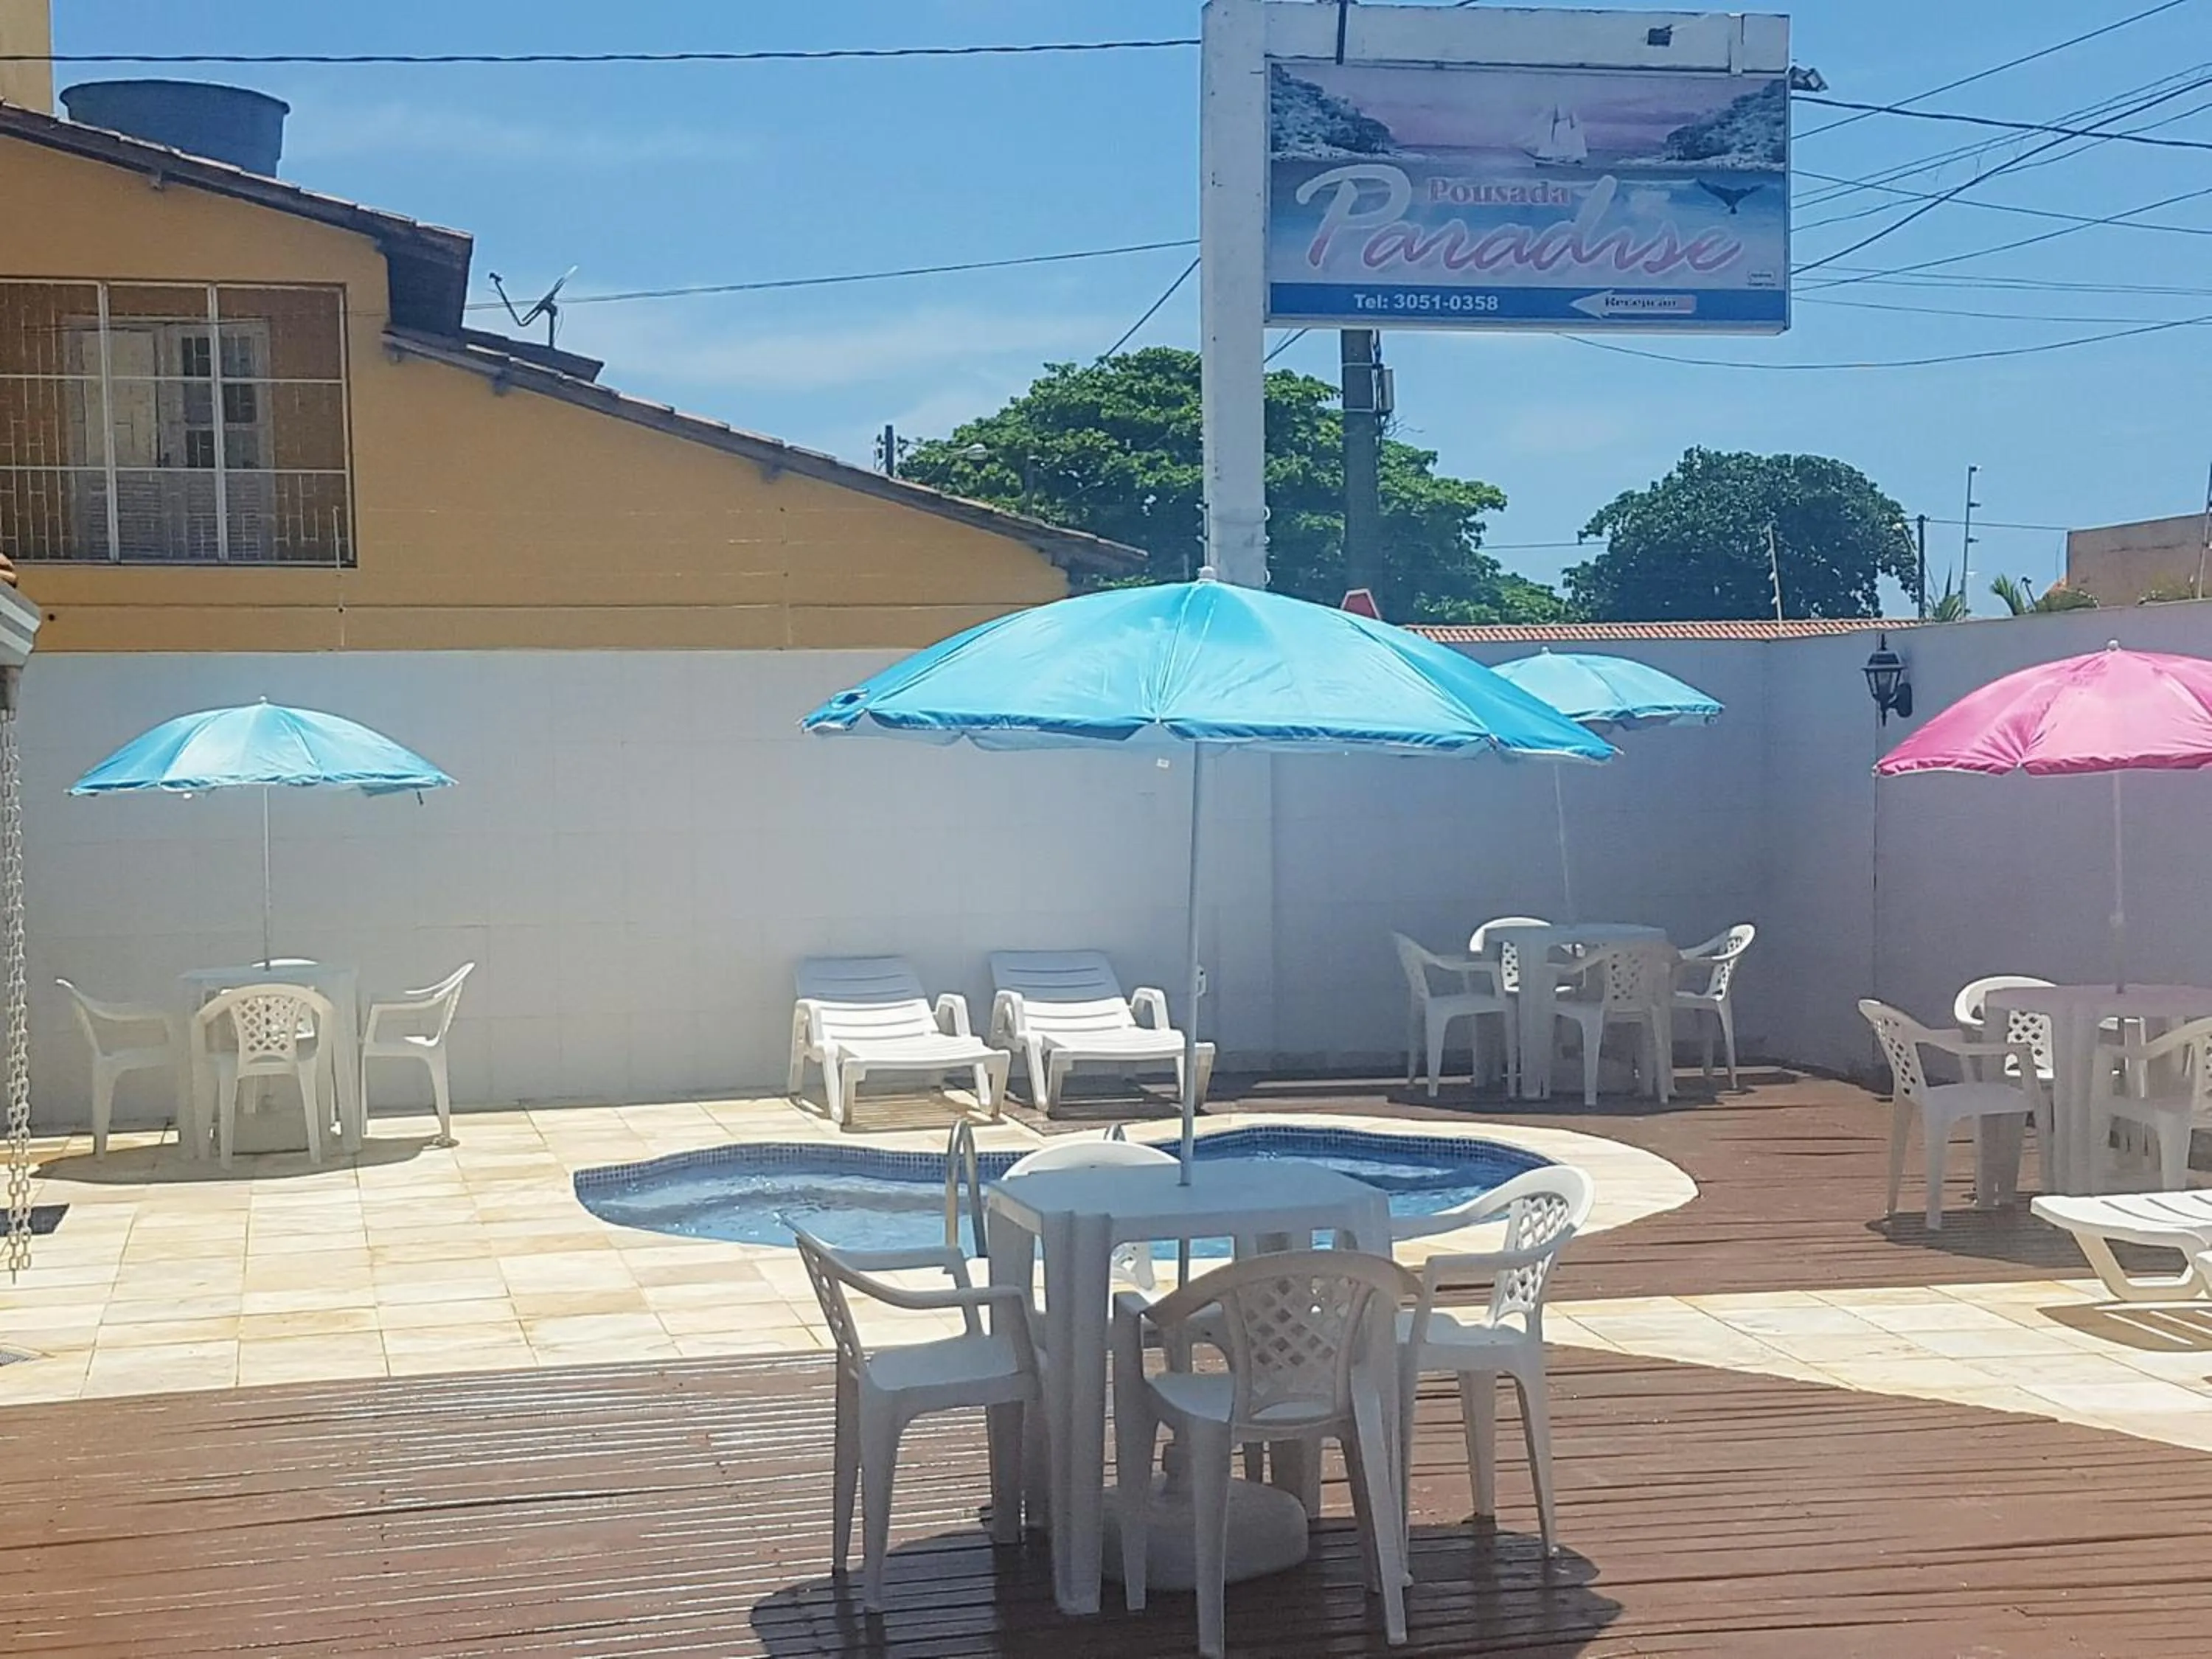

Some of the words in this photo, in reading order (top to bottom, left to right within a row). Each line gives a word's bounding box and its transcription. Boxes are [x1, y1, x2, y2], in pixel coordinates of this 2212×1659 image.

[1429, 178, 1570, 204] Pousada
[1295, 163, 1745, 274] Paradise
[1354, 294, 1388, 309] Tel:
[1393, 294, 1498, 310] 3051-0358
